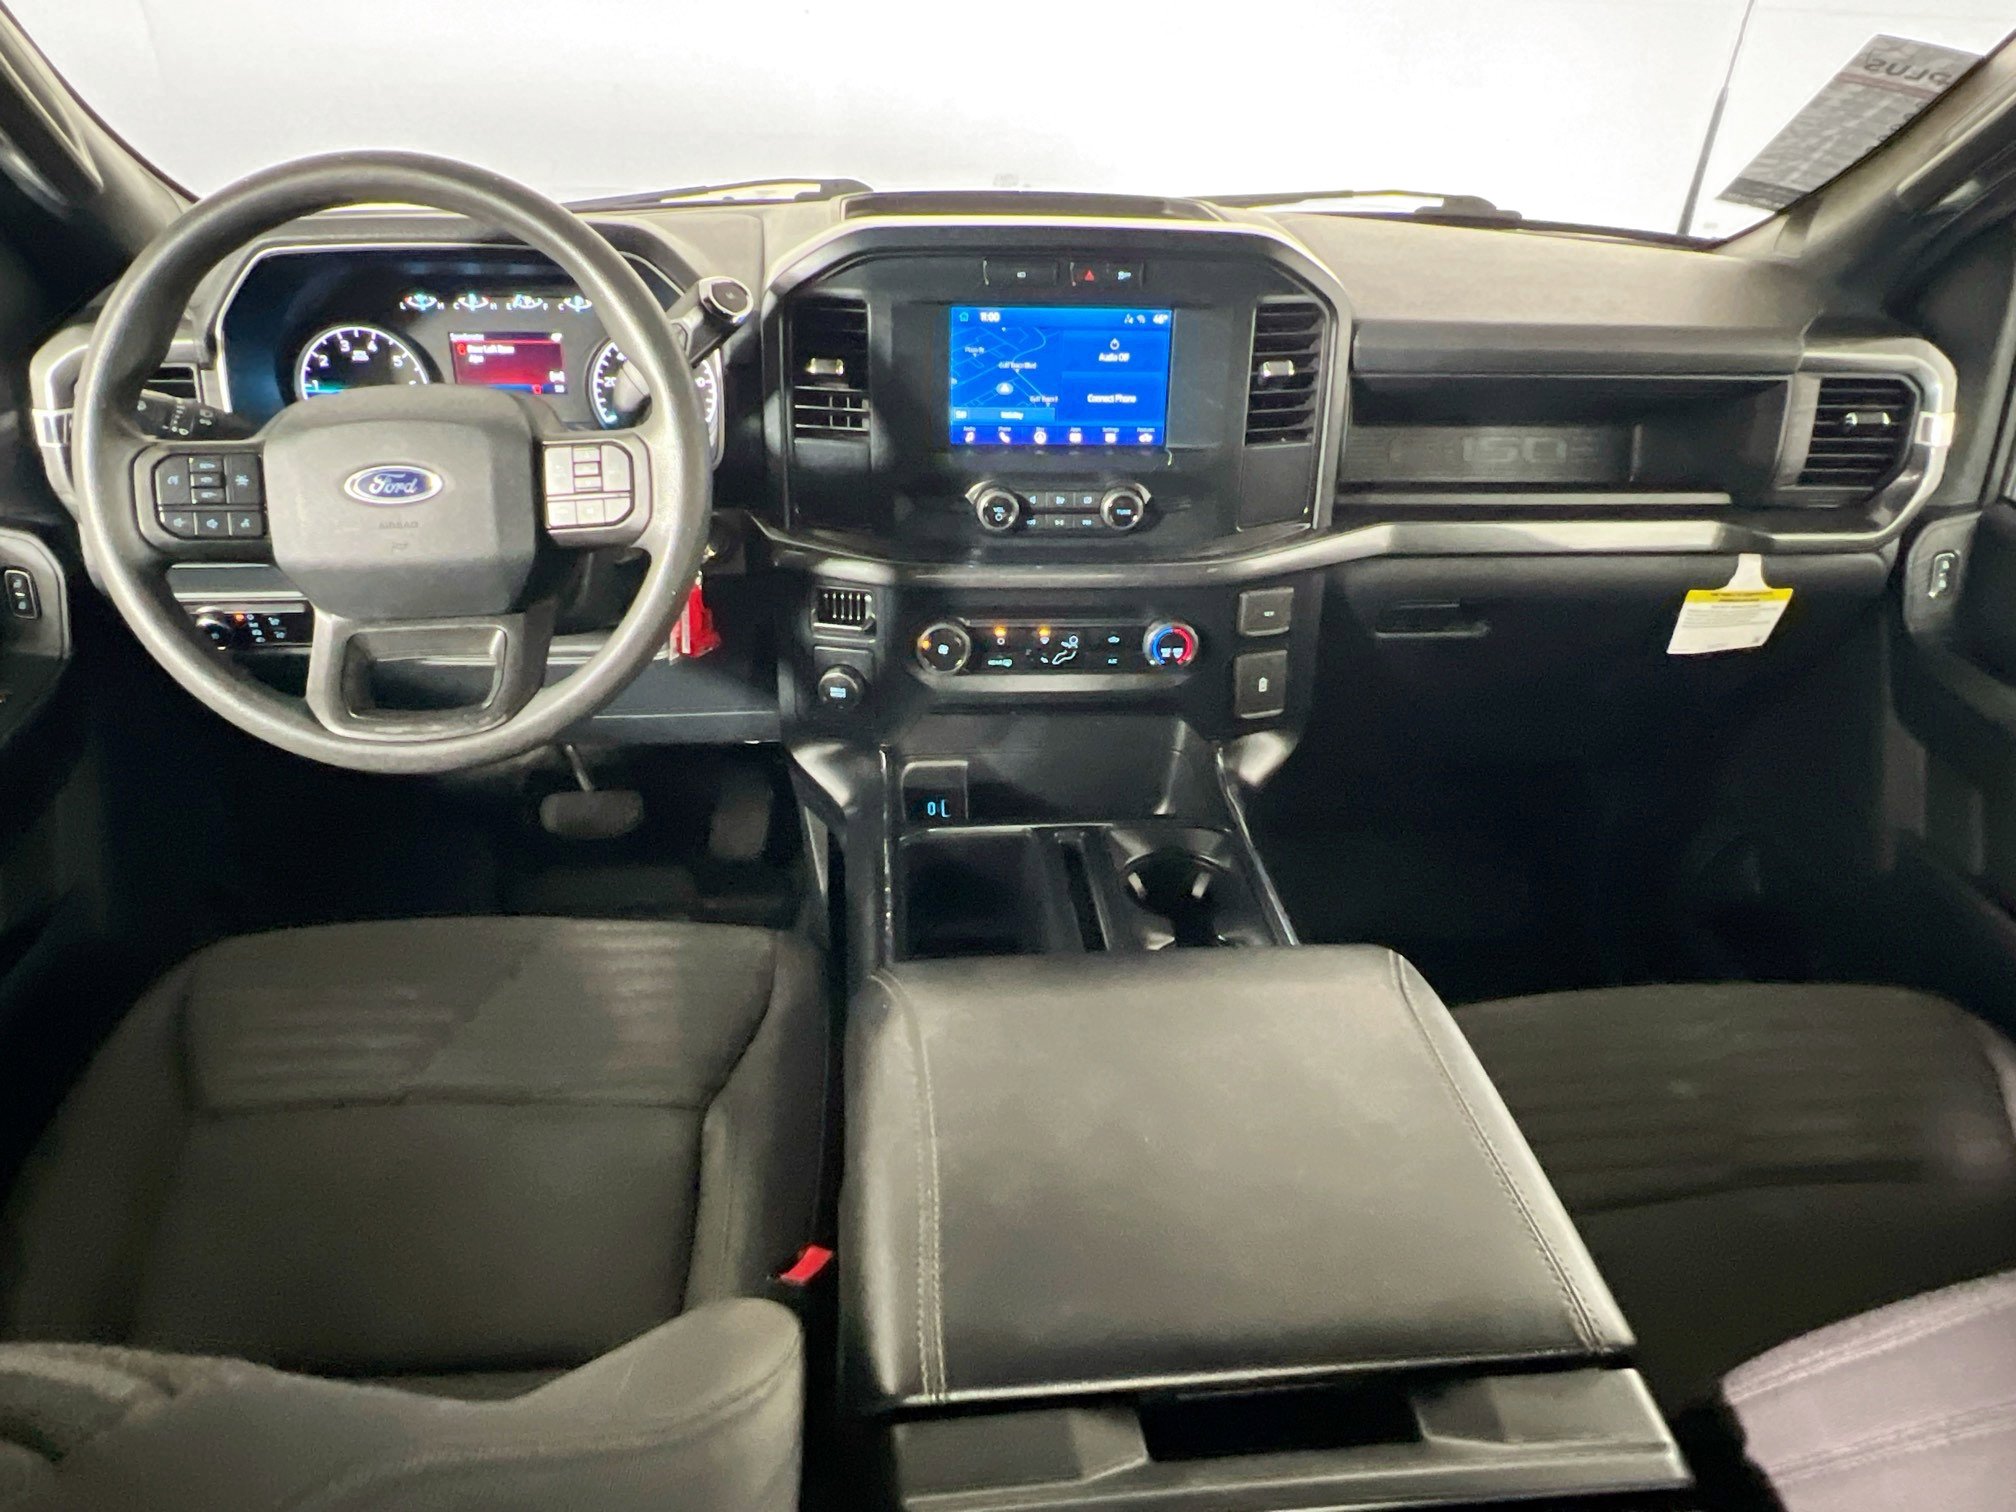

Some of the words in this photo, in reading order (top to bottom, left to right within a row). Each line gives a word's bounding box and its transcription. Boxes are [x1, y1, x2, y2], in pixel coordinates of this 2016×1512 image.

[340, 340, 350, 352] 3
[367, 341, 378, 352] 4
[319, 354, 329, 367] 2
[393, 355, 403, 368] 5
[369, 473, 418, 493] Ford
[379, 521, 419, 529] AIRBAG
